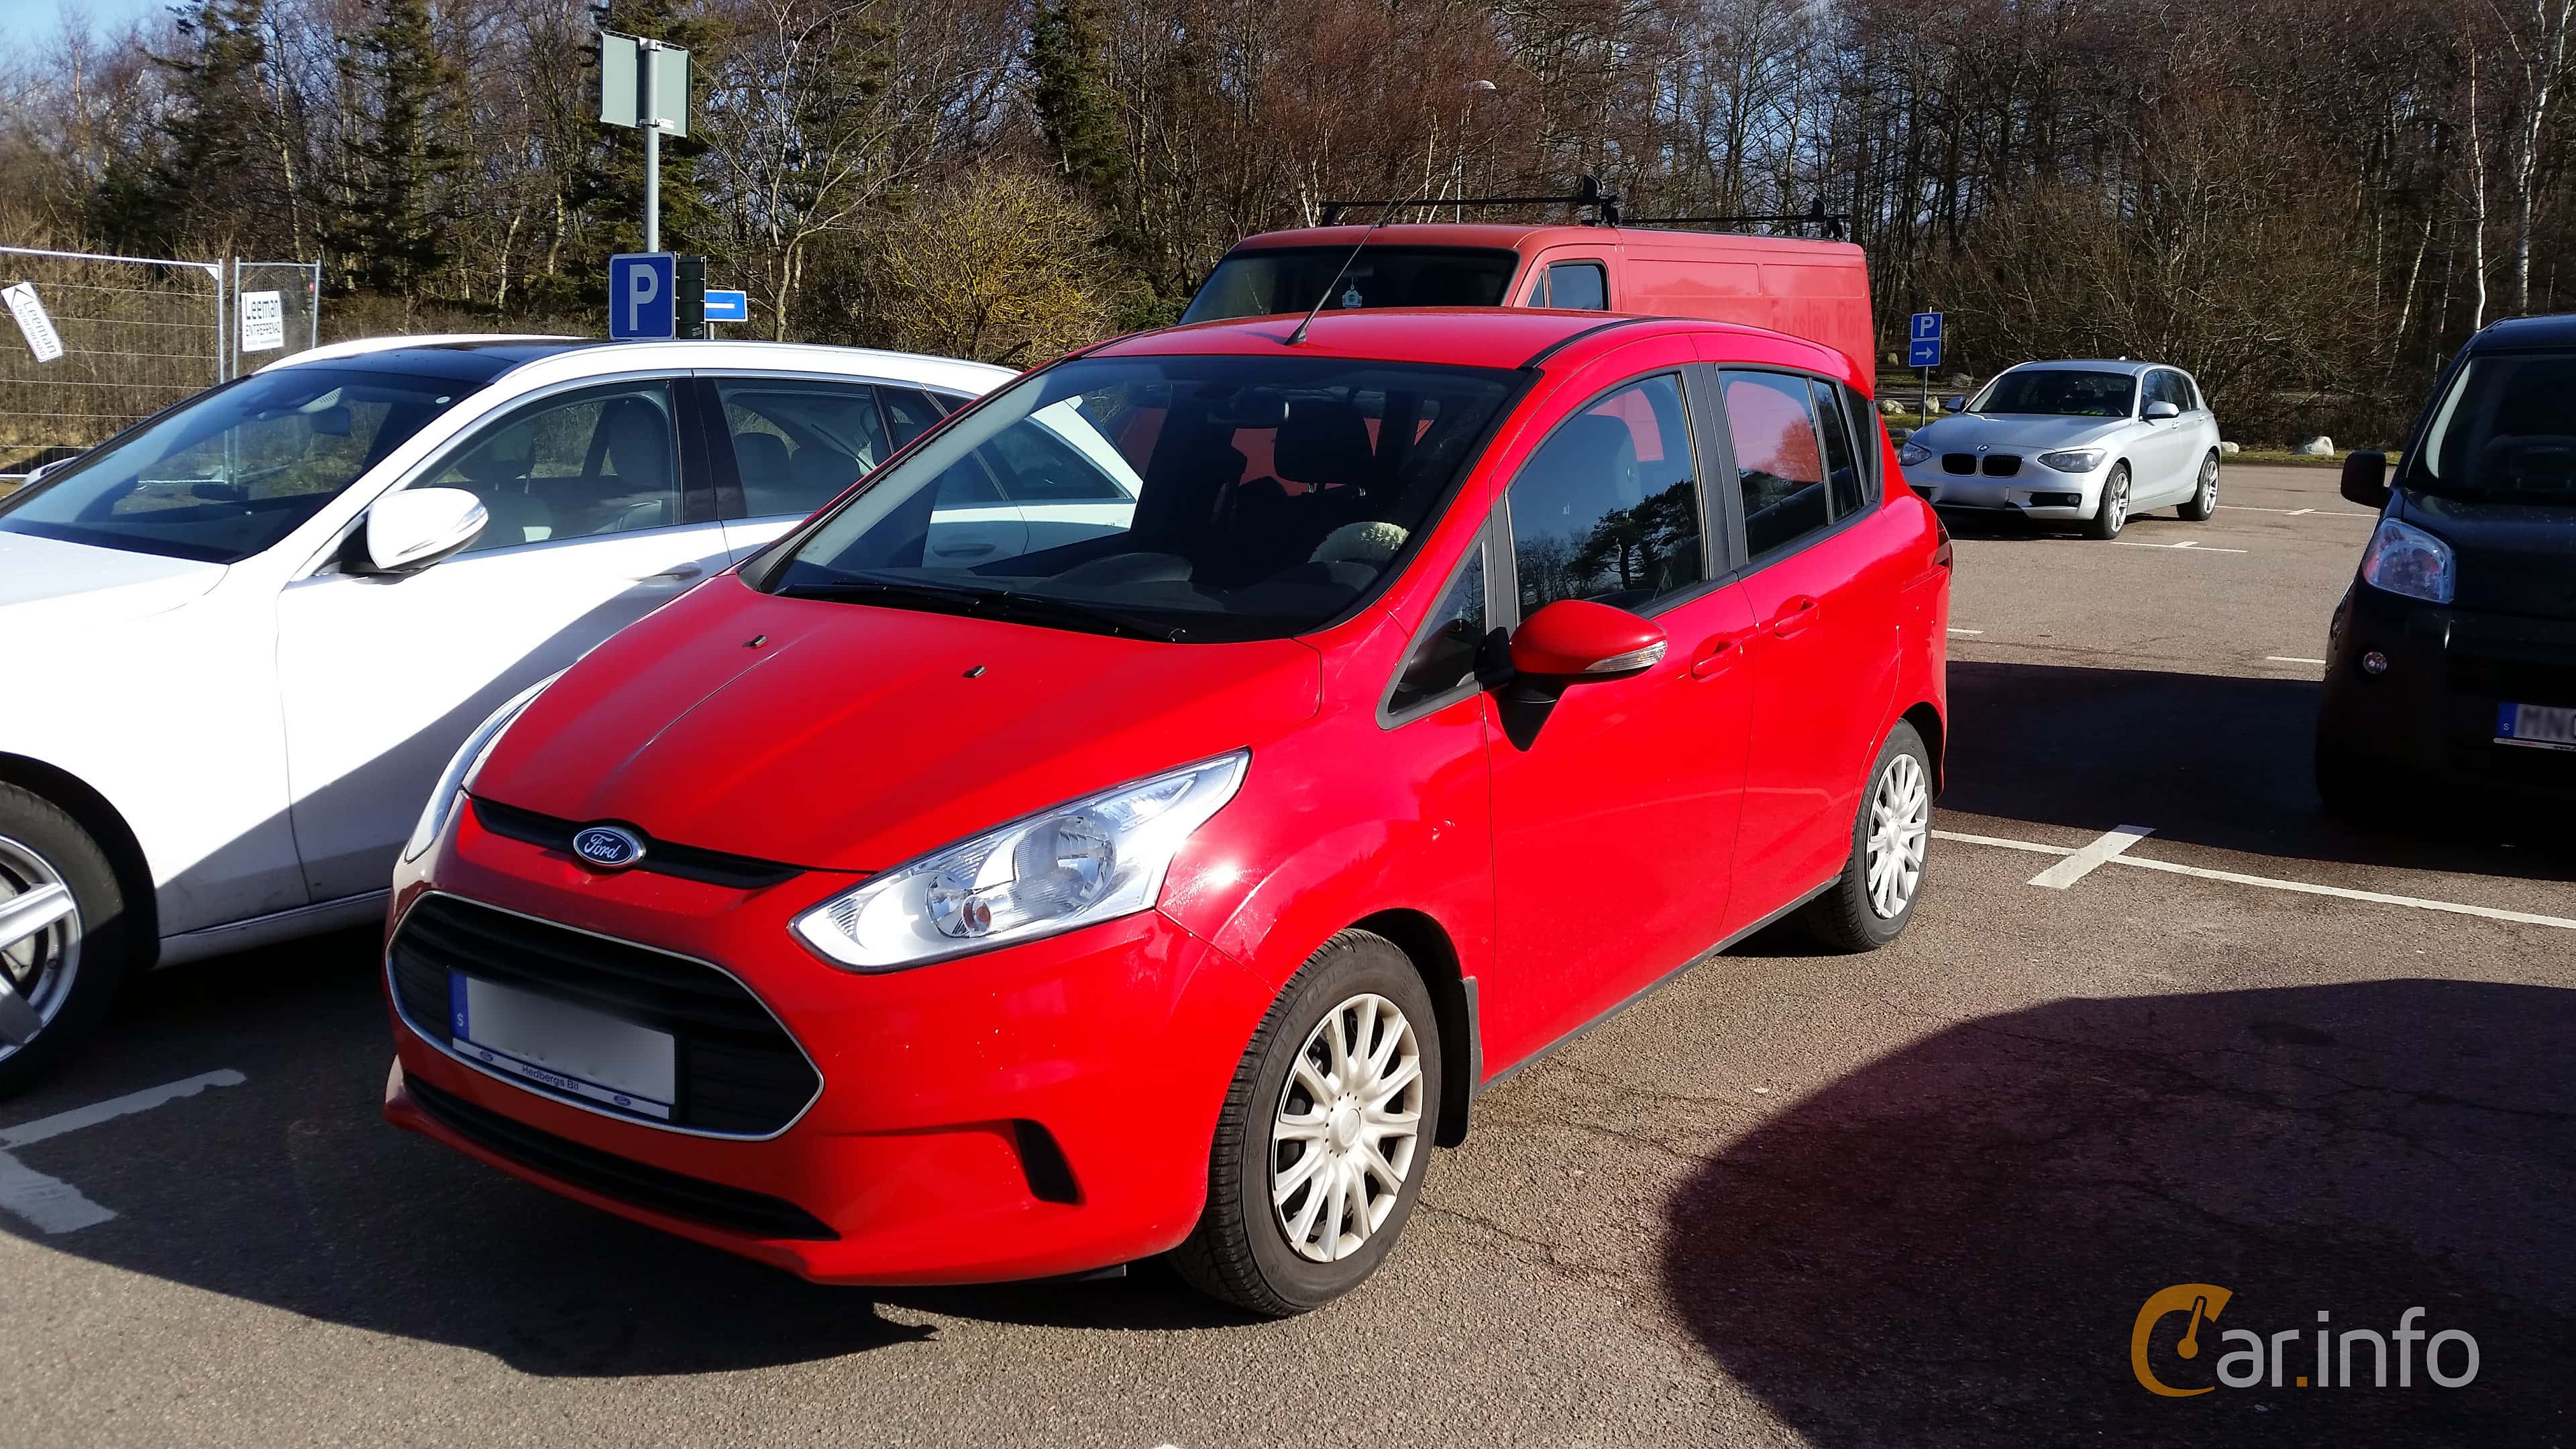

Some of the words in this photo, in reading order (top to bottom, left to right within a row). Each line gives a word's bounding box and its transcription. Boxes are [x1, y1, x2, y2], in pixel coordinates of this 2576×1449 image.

[245, 296, 280, 319] Leeman
[629, 264, 658, 331] P
[23, 301, 57, 354] Leeman
[1920, 316, 1935, 337] P
[584, 834, 622, 859] Ford
[457, 1013, 464, 1027] S
[567, 1079, 580, 1091] Bil
